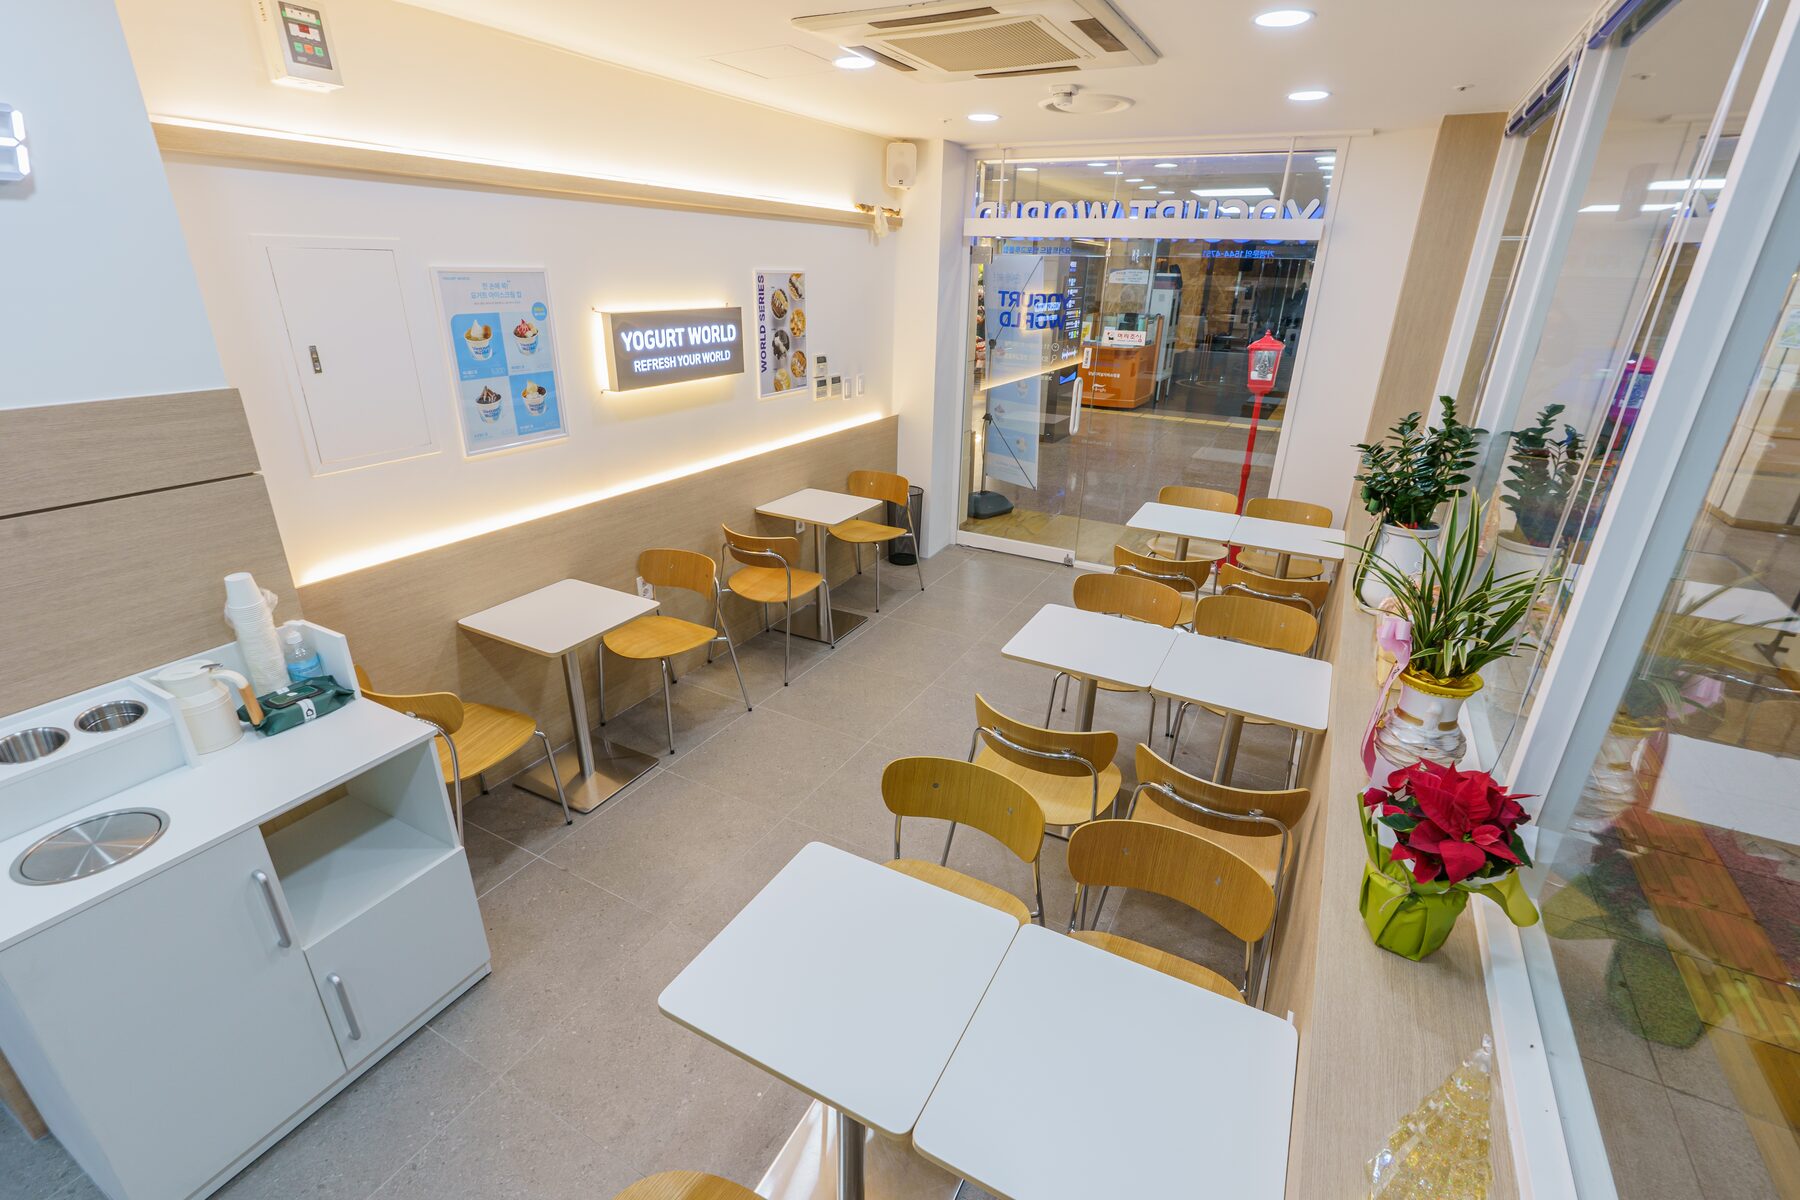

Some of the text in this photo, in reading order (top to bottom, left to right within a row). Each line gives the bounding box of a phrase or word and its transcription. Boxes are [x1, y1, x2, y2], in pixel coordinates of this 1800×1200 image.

[620, 324, 737, 352] YOGURT WORLD
[757, 275, 768, 373] WORLD SERIES
[634, 349, 731, 372] REFRESH YOUR WORLD
